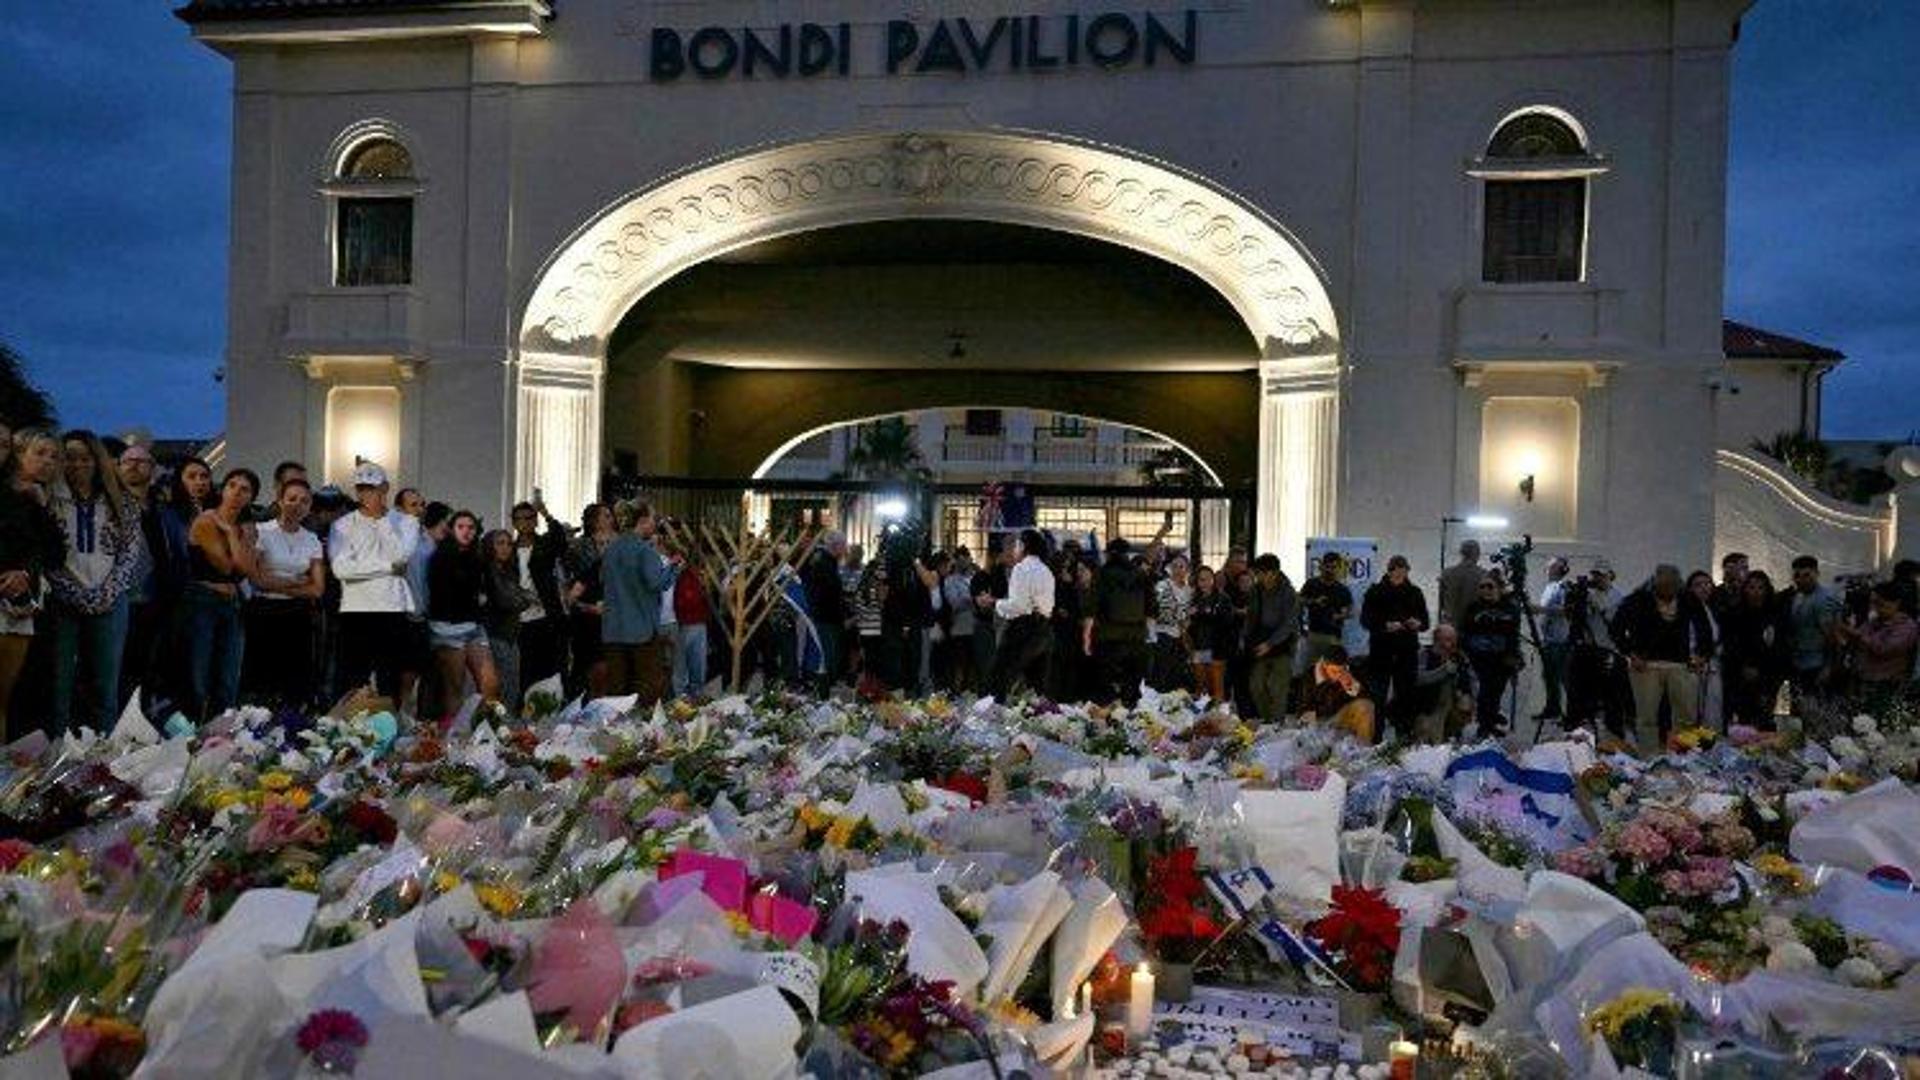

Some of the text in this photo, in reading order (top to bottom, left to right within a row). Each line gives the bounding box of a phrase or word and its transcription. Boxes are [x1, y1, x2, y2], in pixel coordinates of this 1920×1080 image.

[650, 9, 1197, 82] BONDI PAVILION
[1310, 557, 1370, 579] BDI
